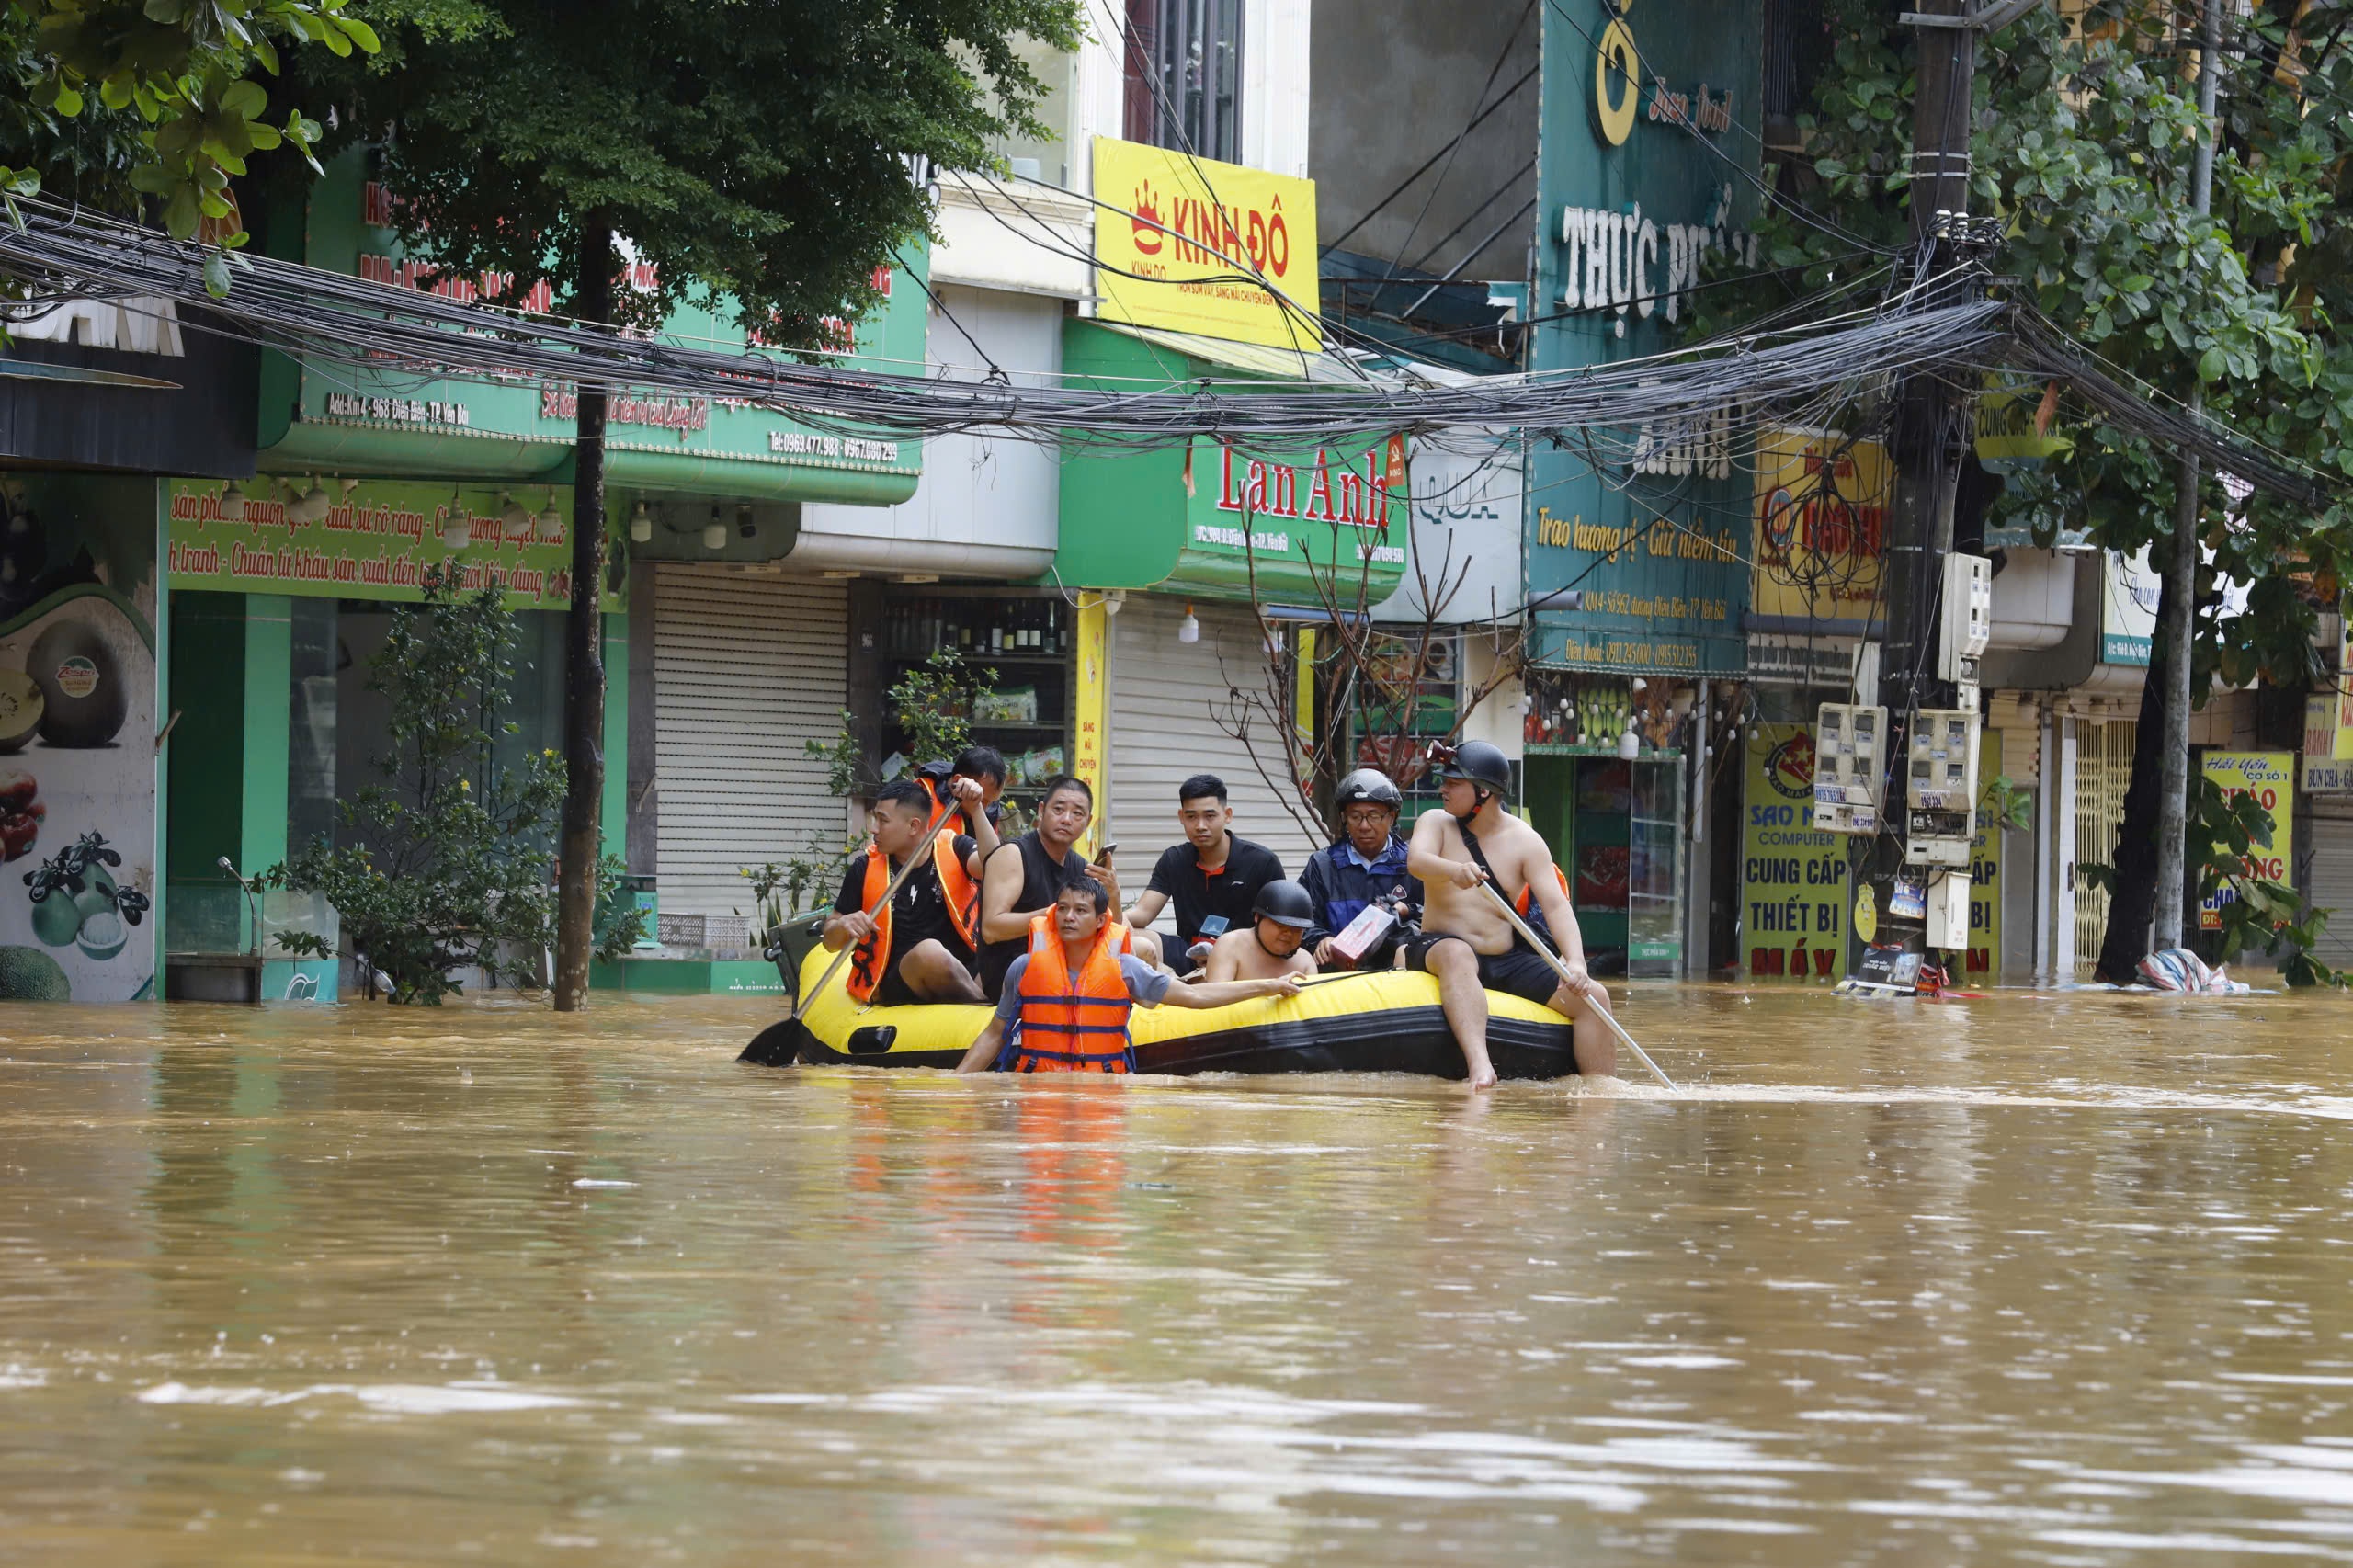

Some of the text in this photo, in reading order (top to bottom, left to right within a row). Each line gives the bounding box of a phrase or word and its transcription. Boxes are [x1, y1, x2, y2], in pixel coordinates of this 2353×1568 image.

[1174, 193, 1289, 278] KINH ĐÔ
[1563, 201, 1658, 338] THỰC
[372, 396, 390, 418] 968
[1979, 407, 2006, 437] CUNG
[1218, 437, 1389, 528] Lan Anh
[171, 485, 197, 521] sản
[243, 484, 285, 535] nguồn
[373, 503, 391, 534] rõ
[391, 502, 424, 547] ràng
[1537, 507, 1570, 547] Trao
[1677, 517, 1715, 562] niềm
[181, 540, 220, 574] tranh
[231, 536, 275, 578] Chuẩn
[278, 543, 292, 579] từ
[294, 546, 329, 582] khâu
[331, 548, 357, 583] sản
[359, 544, 391, 585] xuất
[392, 546, 416, 586] đến
[510, 560, 544, 603] dùng
[1750, 805, 1794, 828] SAO
[1758, 831, 1835, 846] COMPUTER
[1746, 852, 1847, 886] CUNG CẤP
[1972, 853, 1997, 886] ẤP
[1751, 893, 1838, 938] THIẾT BỊ
[1971, 901, 1991, 934] BỊ
[1751, 937, 1836, 976] MÁY
